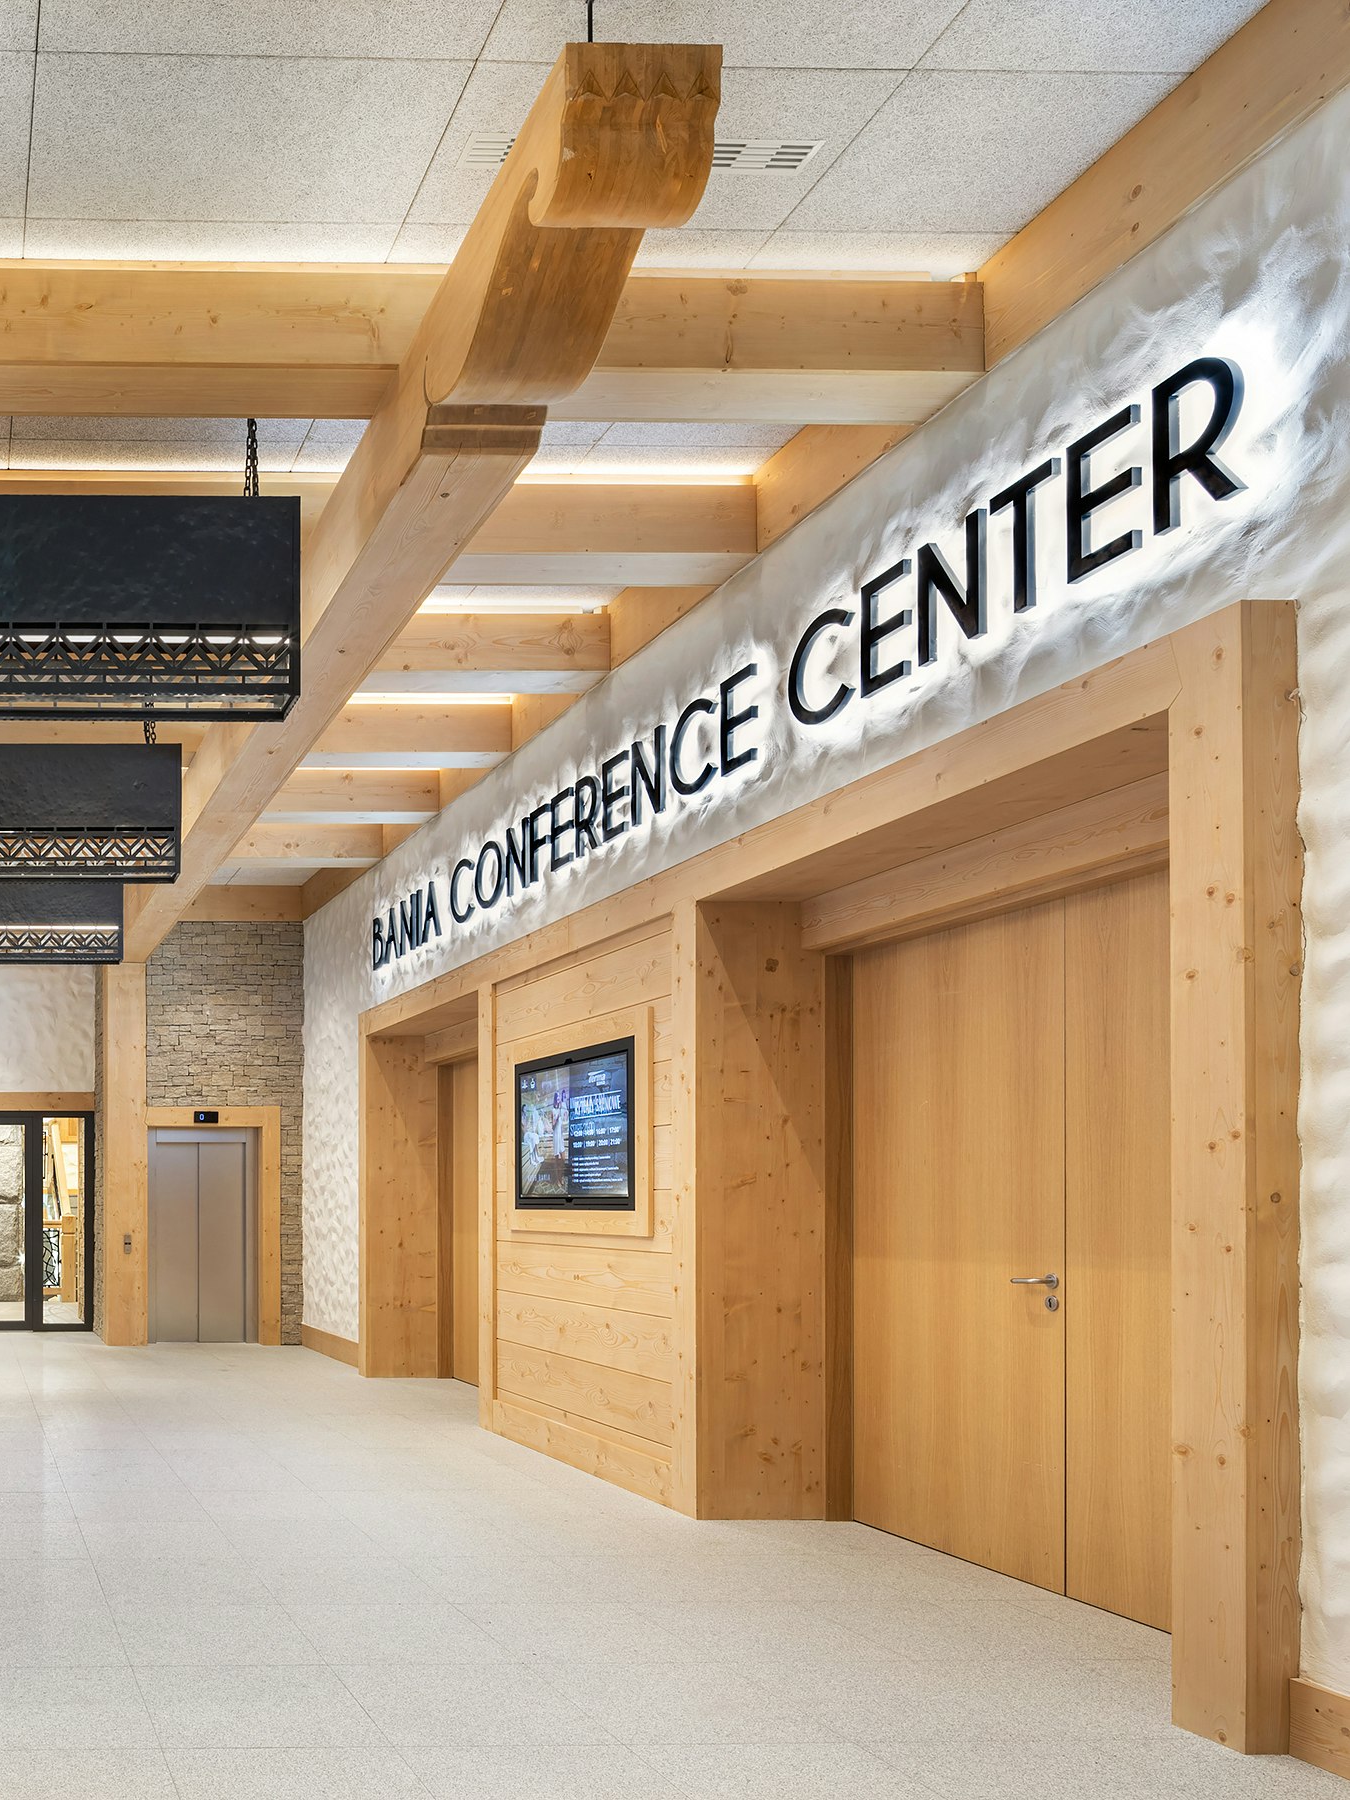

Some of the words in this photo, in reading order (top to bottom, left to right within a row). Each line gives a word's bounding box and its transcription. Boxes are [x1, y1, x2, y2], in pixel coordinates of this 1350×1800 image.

[372, 880, 442, 970] BANIA
[449, 663, 759, 924] CONFERENCE
[787, 356, 1248, 725] CENTER
